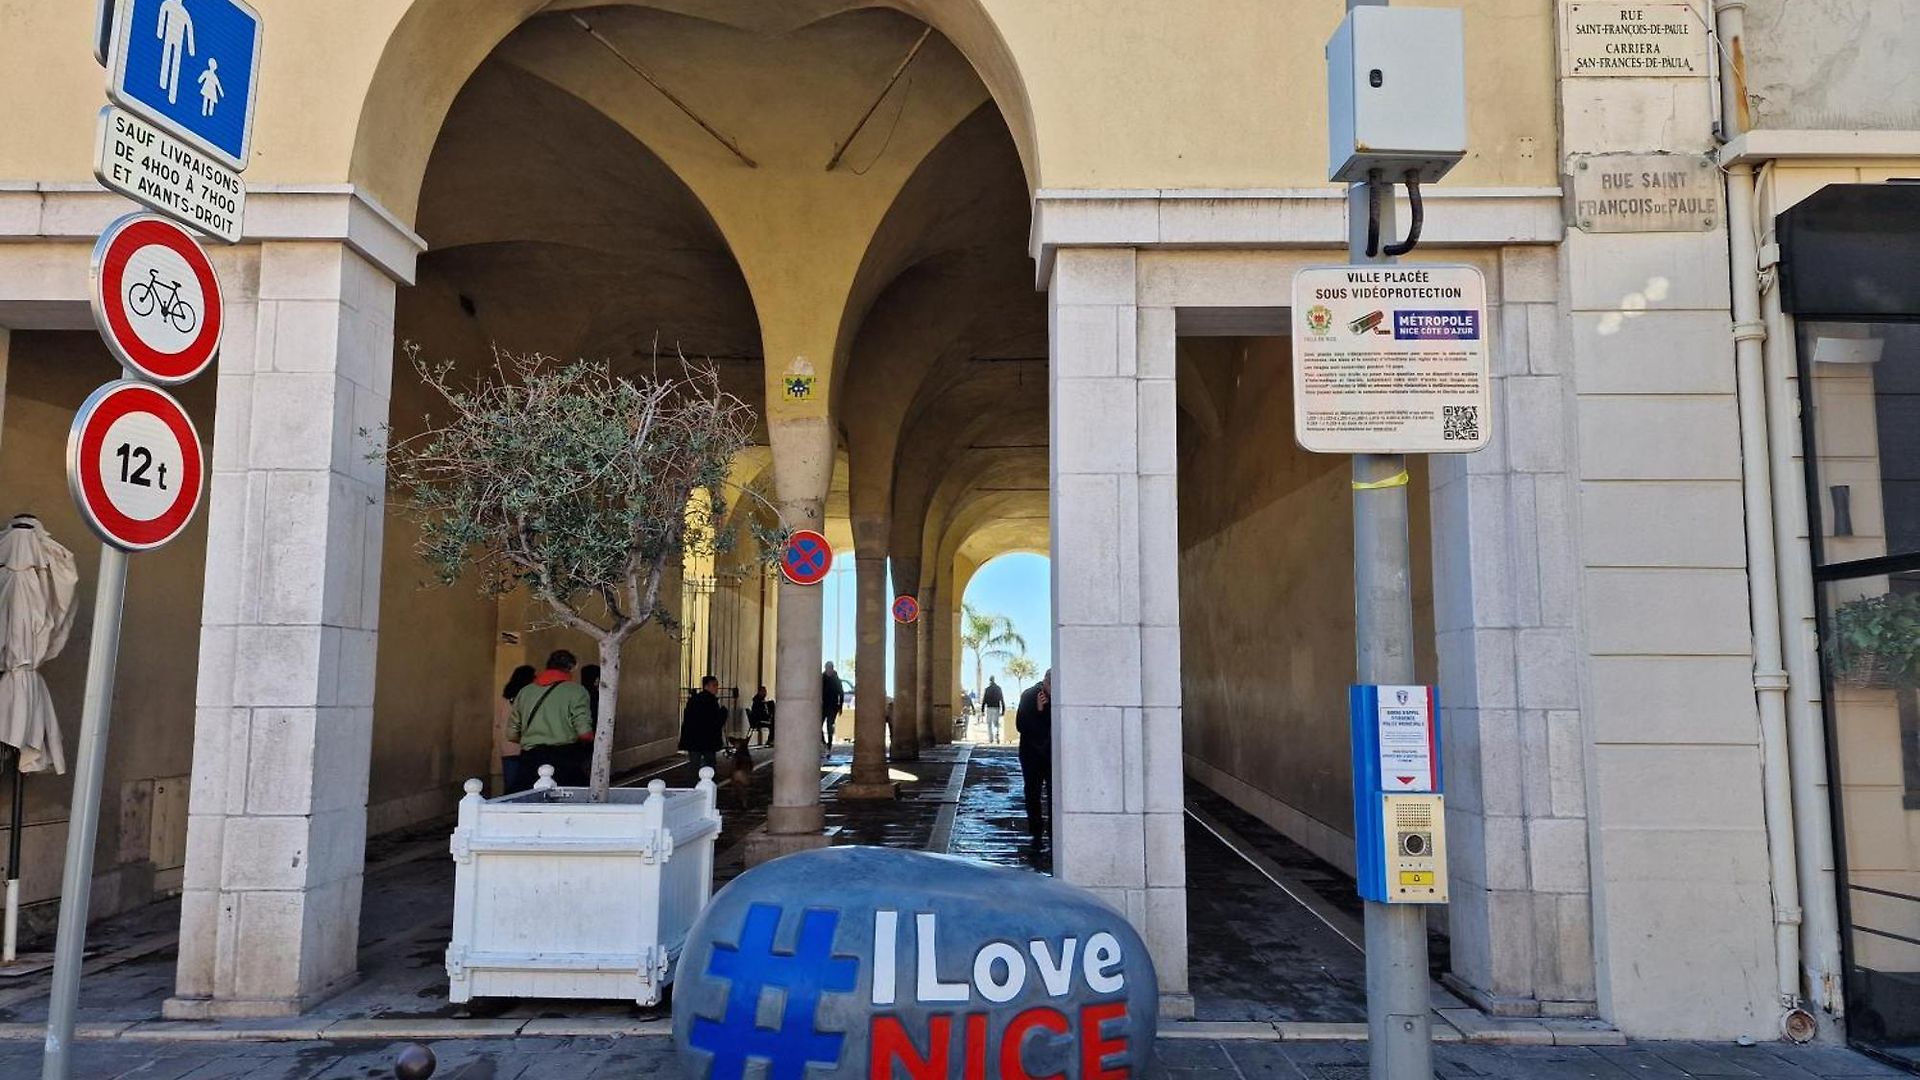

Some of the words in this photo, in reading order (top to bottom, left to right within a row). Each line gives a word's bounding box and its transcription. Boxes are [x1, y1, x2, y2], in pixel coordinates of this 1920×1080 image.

[1620, 10, 1643, 21] RUE
[1576, 24, 1689, 36] SAINT-FRANÇOIS-DE-PAULE
[1605, 43, 1661, 54] CARRIERA
[115, 116, 156, 148] SAUF
[160, 140, 240, 195] LIVRAISONS
[115, 140, 135, 163] DE
[141, 156, 181, 186] 4H00
[185, 176, 195, 193] À
[201, 185, 236, 214] 7H00
[1601, 173, 1634, 189] RUE
[1642, 172, 1687, 188] SAINT
[113, 164, 133, 184] ET
[137, 177, 234, 234] AYANTS-DROIT
[1578, 198, 1653, 217] FRANÇOIS
[1669, 198, 1716, 214] PAULE
[1347, 272, 1380, 283] VILLE
[1384, 270, 1429, 283] PLACÉE
[1315, 288, 1348, 299] SOUS
[1352, 286, 1462, 299] VIDÉOPROTECTION
[1399, 314, 1473, 326] MÉTROPOLE
[1399, 327, 1419, 335] NICE
[1421, 326, 1442, 335] CÔTE
[1444, 327, 1474, 335] D'AZUR
[869, 1001, 1131, 1080] NICE
